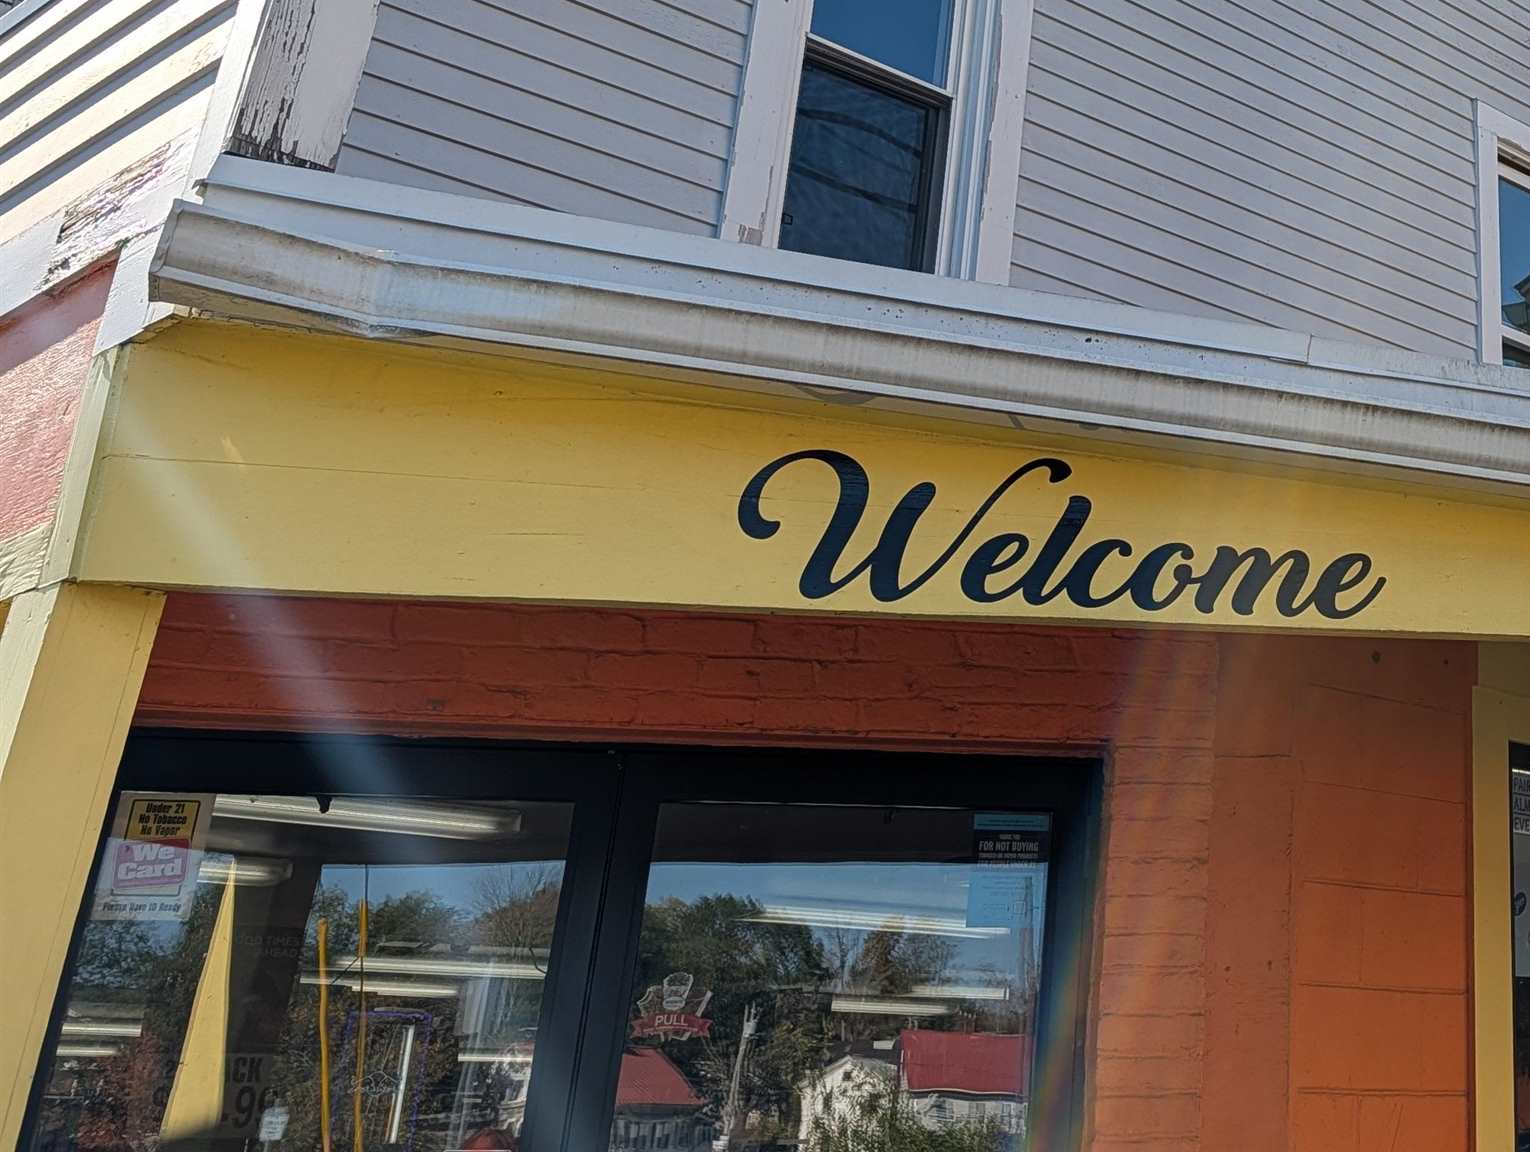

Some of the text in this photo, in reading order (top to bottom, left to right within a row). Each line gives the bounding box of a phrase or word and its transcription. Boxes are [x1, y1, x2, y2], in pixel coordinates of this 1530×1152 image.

[738, 449, 1386, 619] Welcome
[146, 803, 185, 813] Under 21
[138, 814, 187, 825] No Tobacco
[141, 824, 182, 836] No Vapor
[979, 840, 1039, 852] FOR NOT BUYING
[132, 844, 175, 861] We
[117, 858, 183, 880] Card
[655, 1014, 689, 1026] PULL
